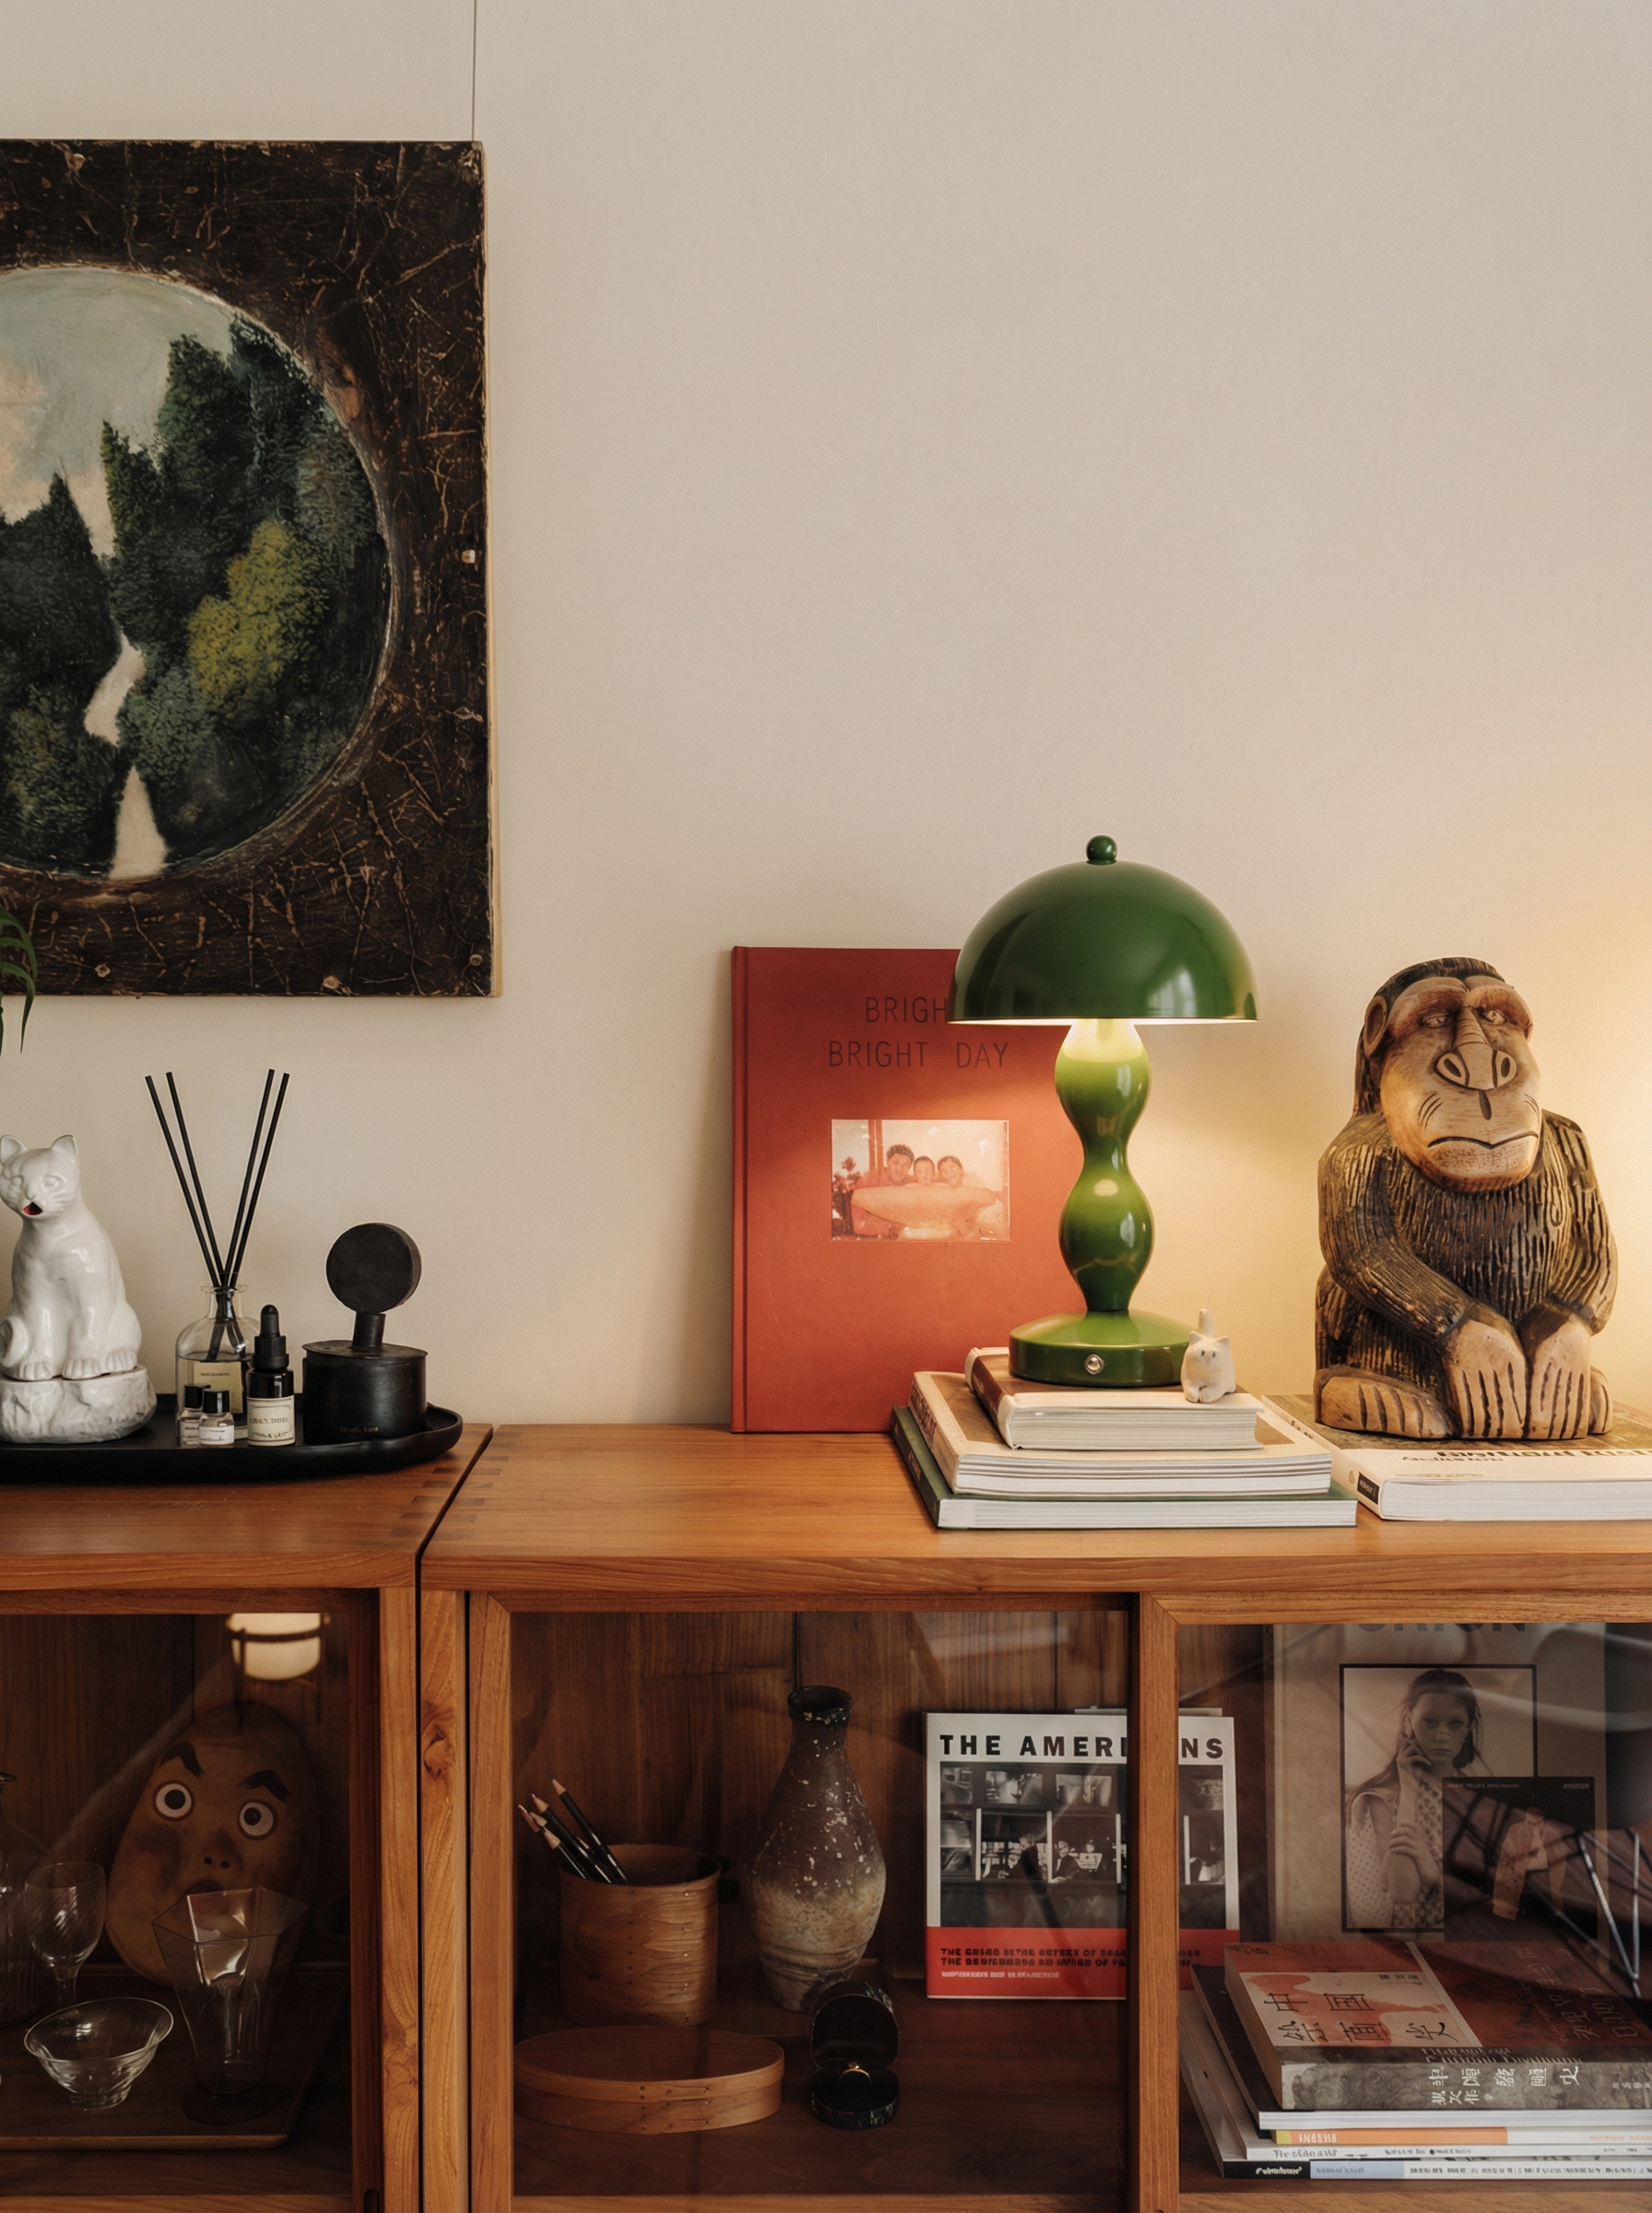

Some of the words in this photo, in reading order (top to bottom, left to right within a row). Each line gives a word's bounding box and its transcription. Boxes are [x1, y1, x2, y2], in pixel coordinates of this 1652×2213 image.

[866, 996, 948, 1024] BRIGH
[829, 1040, 928, 1068] BRIGHT
[956, 1041, 1009, 1069] DAY
[939, 1734, 1001, 1756] THE
[1019, 1735, 1224, 1760] AMERINS
